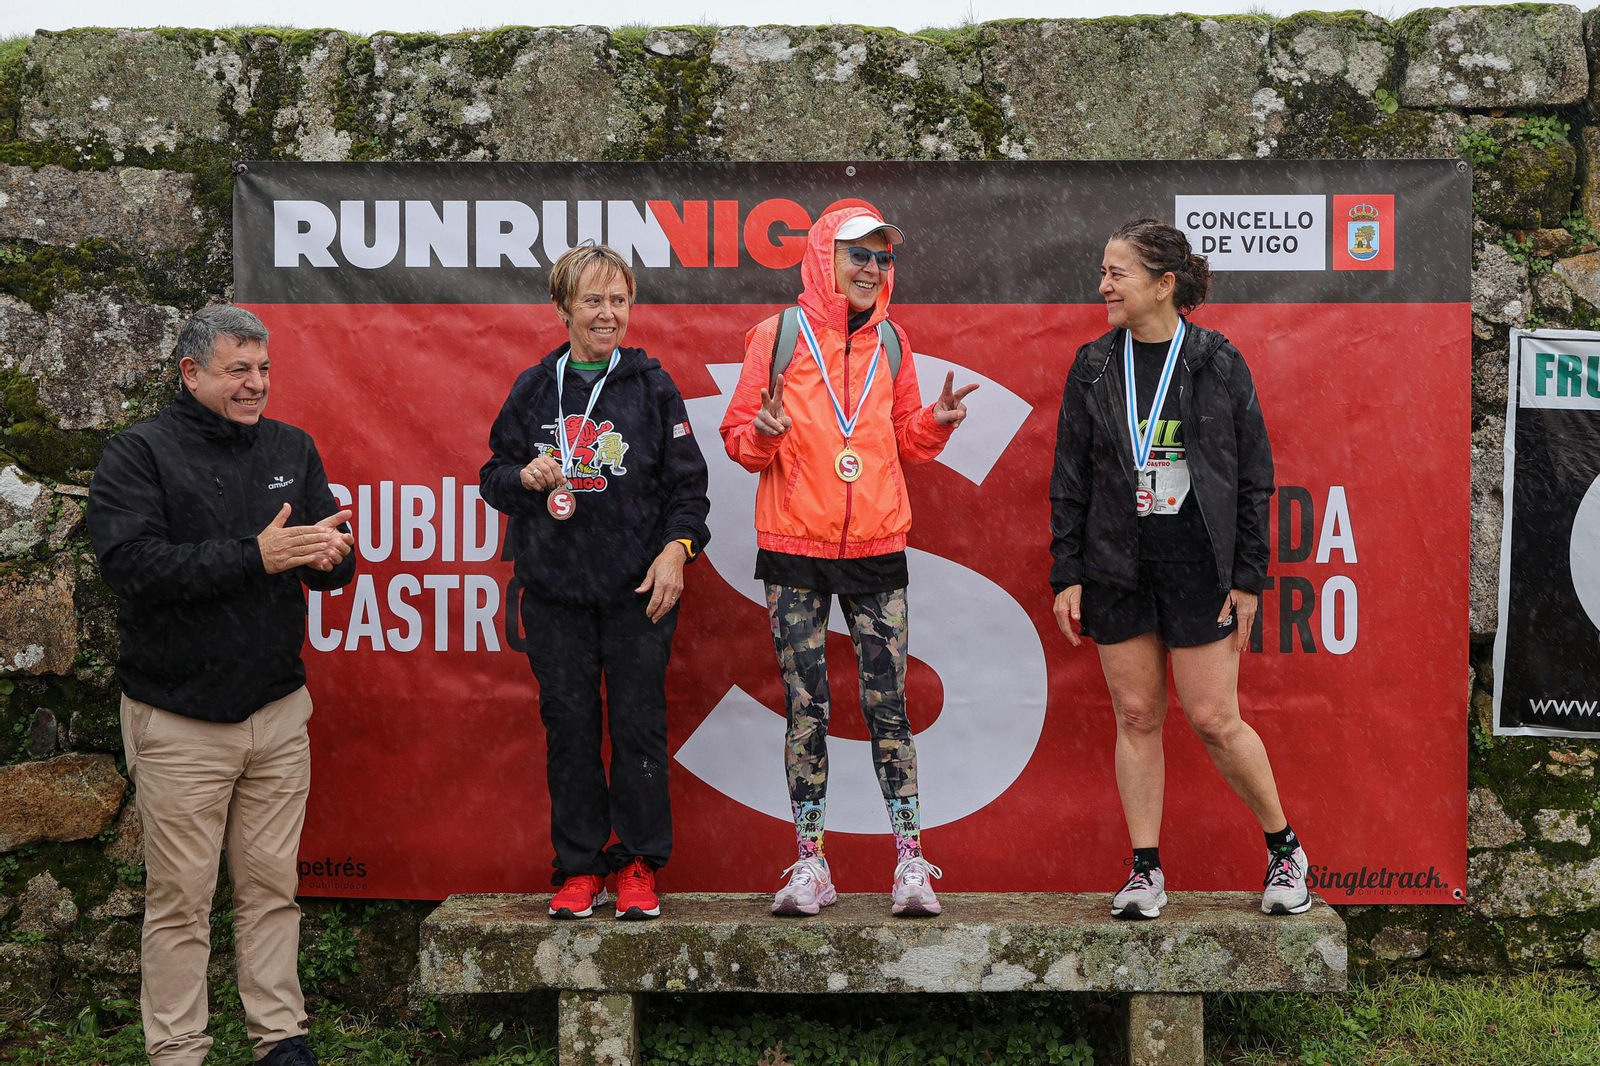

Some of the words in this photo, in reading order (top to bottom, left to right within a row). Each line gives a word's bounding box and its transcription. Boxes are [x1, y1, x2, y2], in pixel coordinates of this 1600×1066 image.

[1186, 211, 1313, 230] CONCELLO
[273, 198, 886, 269] RUNRUNVIG
[1202, 236, 1232, 254] DE
[1241, 236, 1299, 254] VIGO
[268, 478, 294, 490] amura
